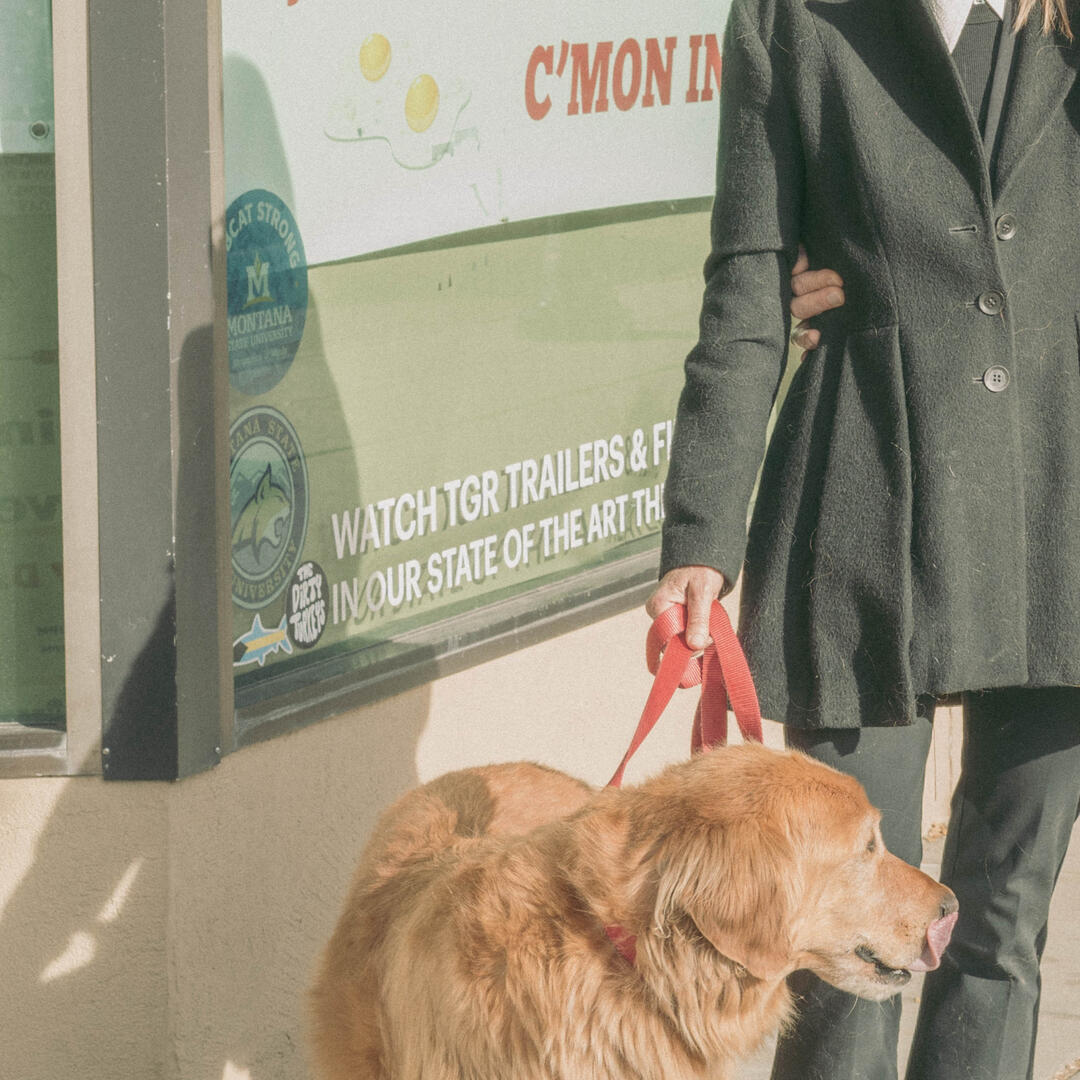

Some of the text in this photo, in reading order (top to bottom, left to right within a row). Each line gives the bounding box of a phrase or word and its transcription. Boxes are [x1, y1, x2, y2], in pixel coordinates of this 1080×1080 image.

[524, 37, 678, 121] C'MON
[257, 201, 300, 269] STRONG
[331, 485, 437, 560] WATCH
[443, 469, 500, 527] TGR
[505, 433, 625, 508] TRAILERS
[630, 428, 648, 472] &
[332, 577, 359, 625] IN
[366, 558, 422, 612] OUR
[427, 534, 498, 593] STATE
[503, 521, 534, 569] OF
[539, 508, 584, 556] THE
[587, 494, 629, 543] ART
